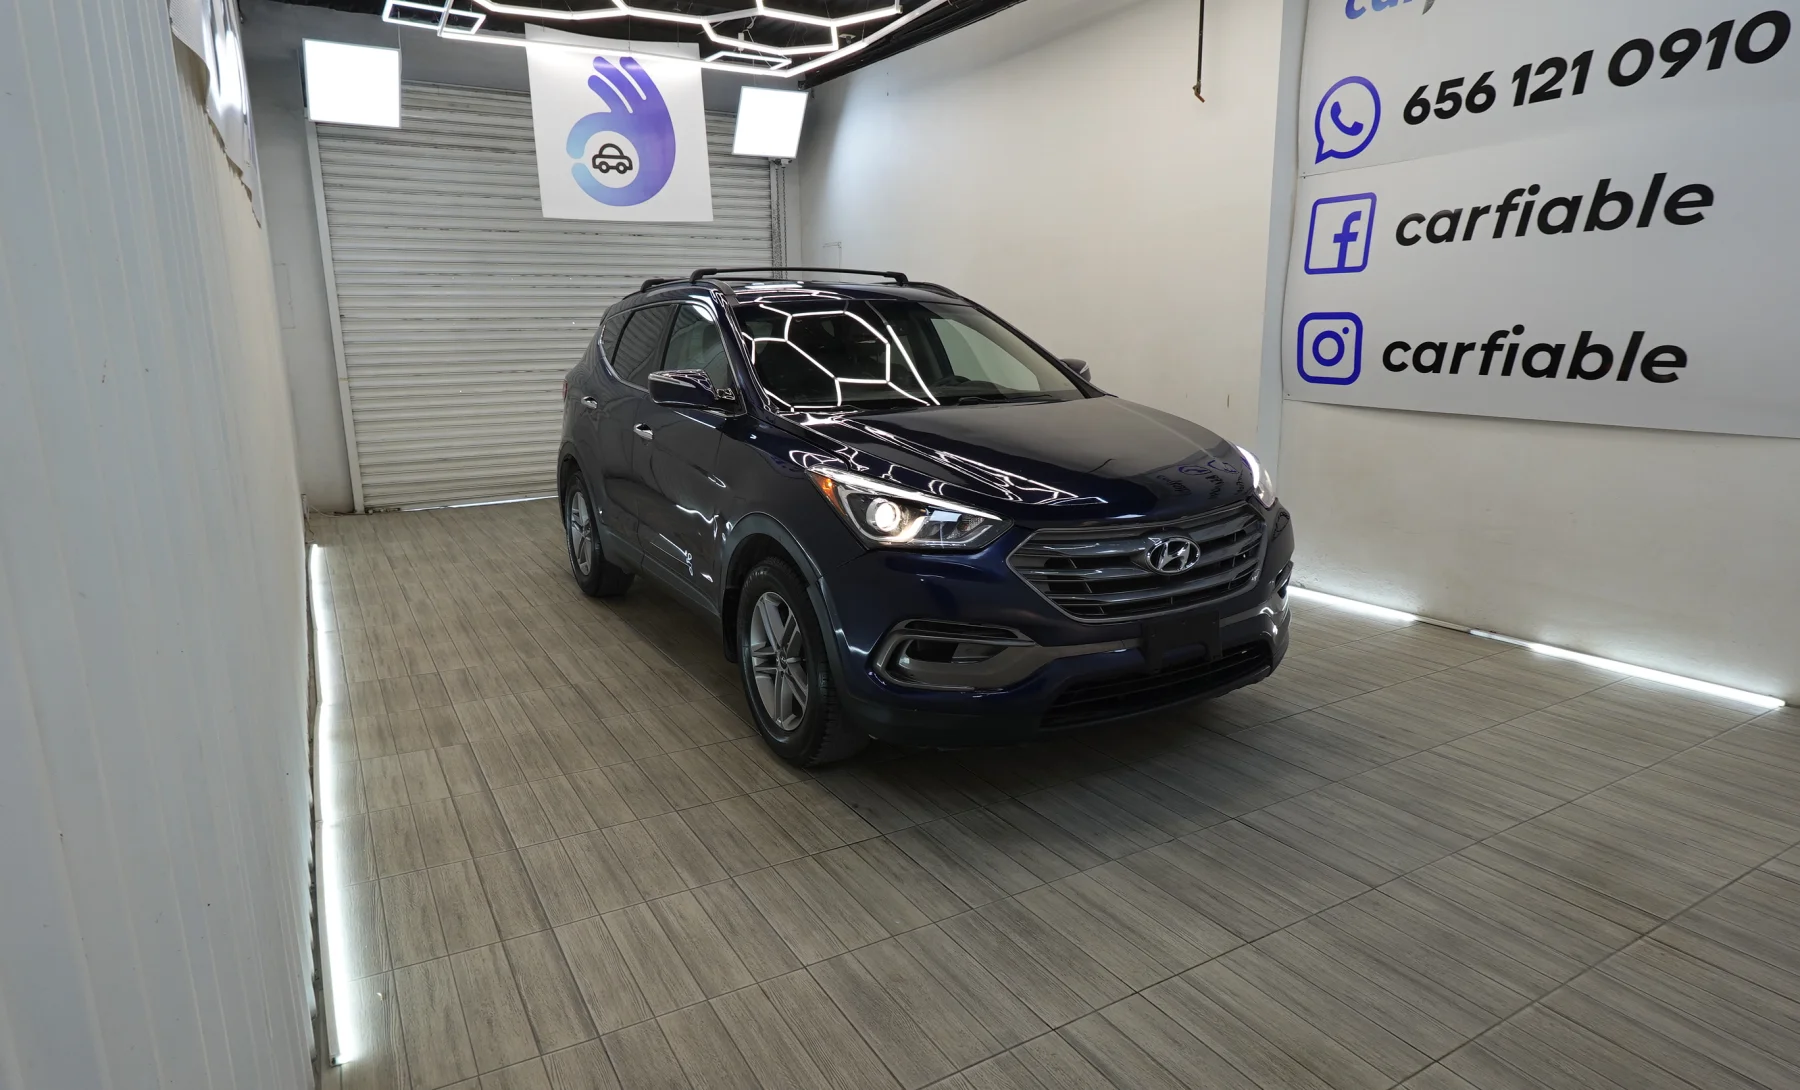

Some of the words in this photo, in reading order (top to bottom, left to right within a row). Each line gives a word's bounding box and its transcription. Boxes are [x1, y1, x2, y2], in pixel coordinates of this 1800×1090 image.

[1402, 70, 1497, 126] 656
[1511, 49, 1595, 107] 121
[1607, 9, 1792, 88] 0910
[1395, 172, 1715, 247] carfiable
[1382, 323, 1688, 384] carfiable
